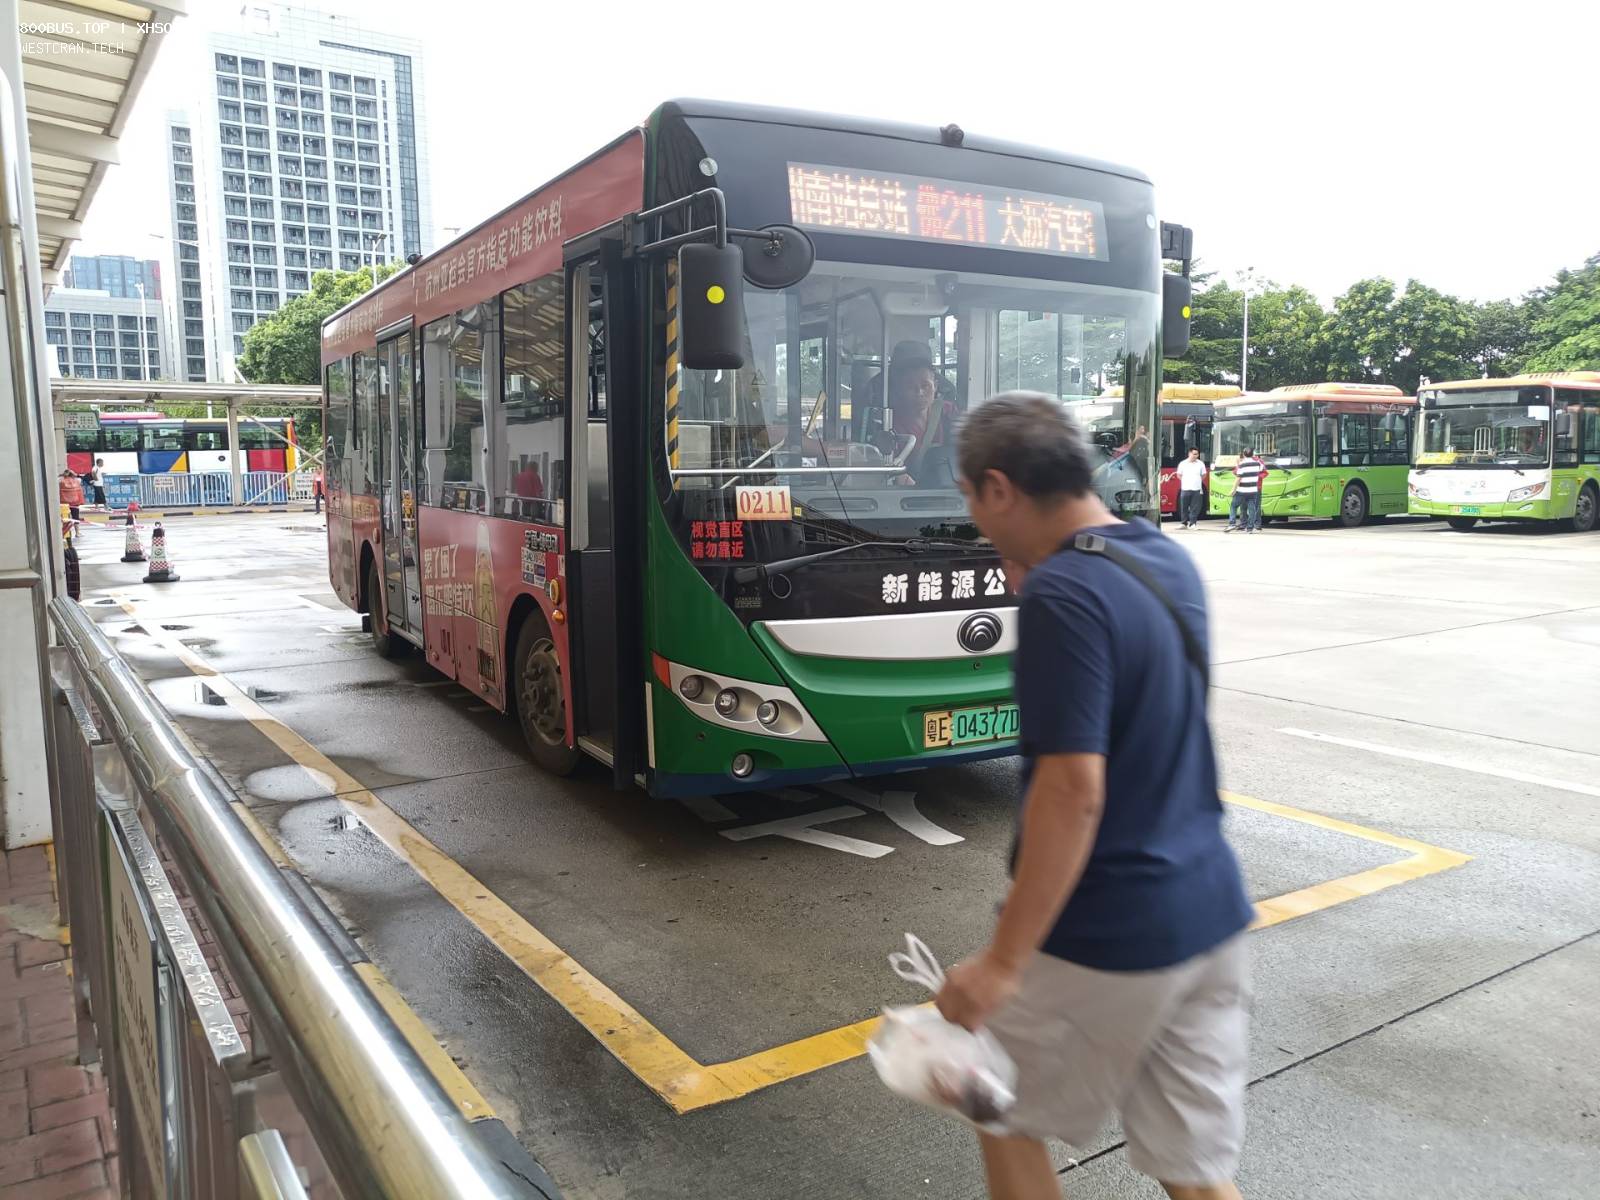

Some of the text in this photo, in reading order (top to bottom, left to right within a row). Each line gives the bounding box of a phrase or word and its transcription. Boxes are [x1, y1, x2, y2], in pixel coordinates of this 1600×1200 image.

[739, 490, 789, 514] 0211
[691, 521, 744, 538] 视觉盲区
[691, 541, 744, 559] 请勿靠近
[882, 567, 1007, 604] 新能源公
